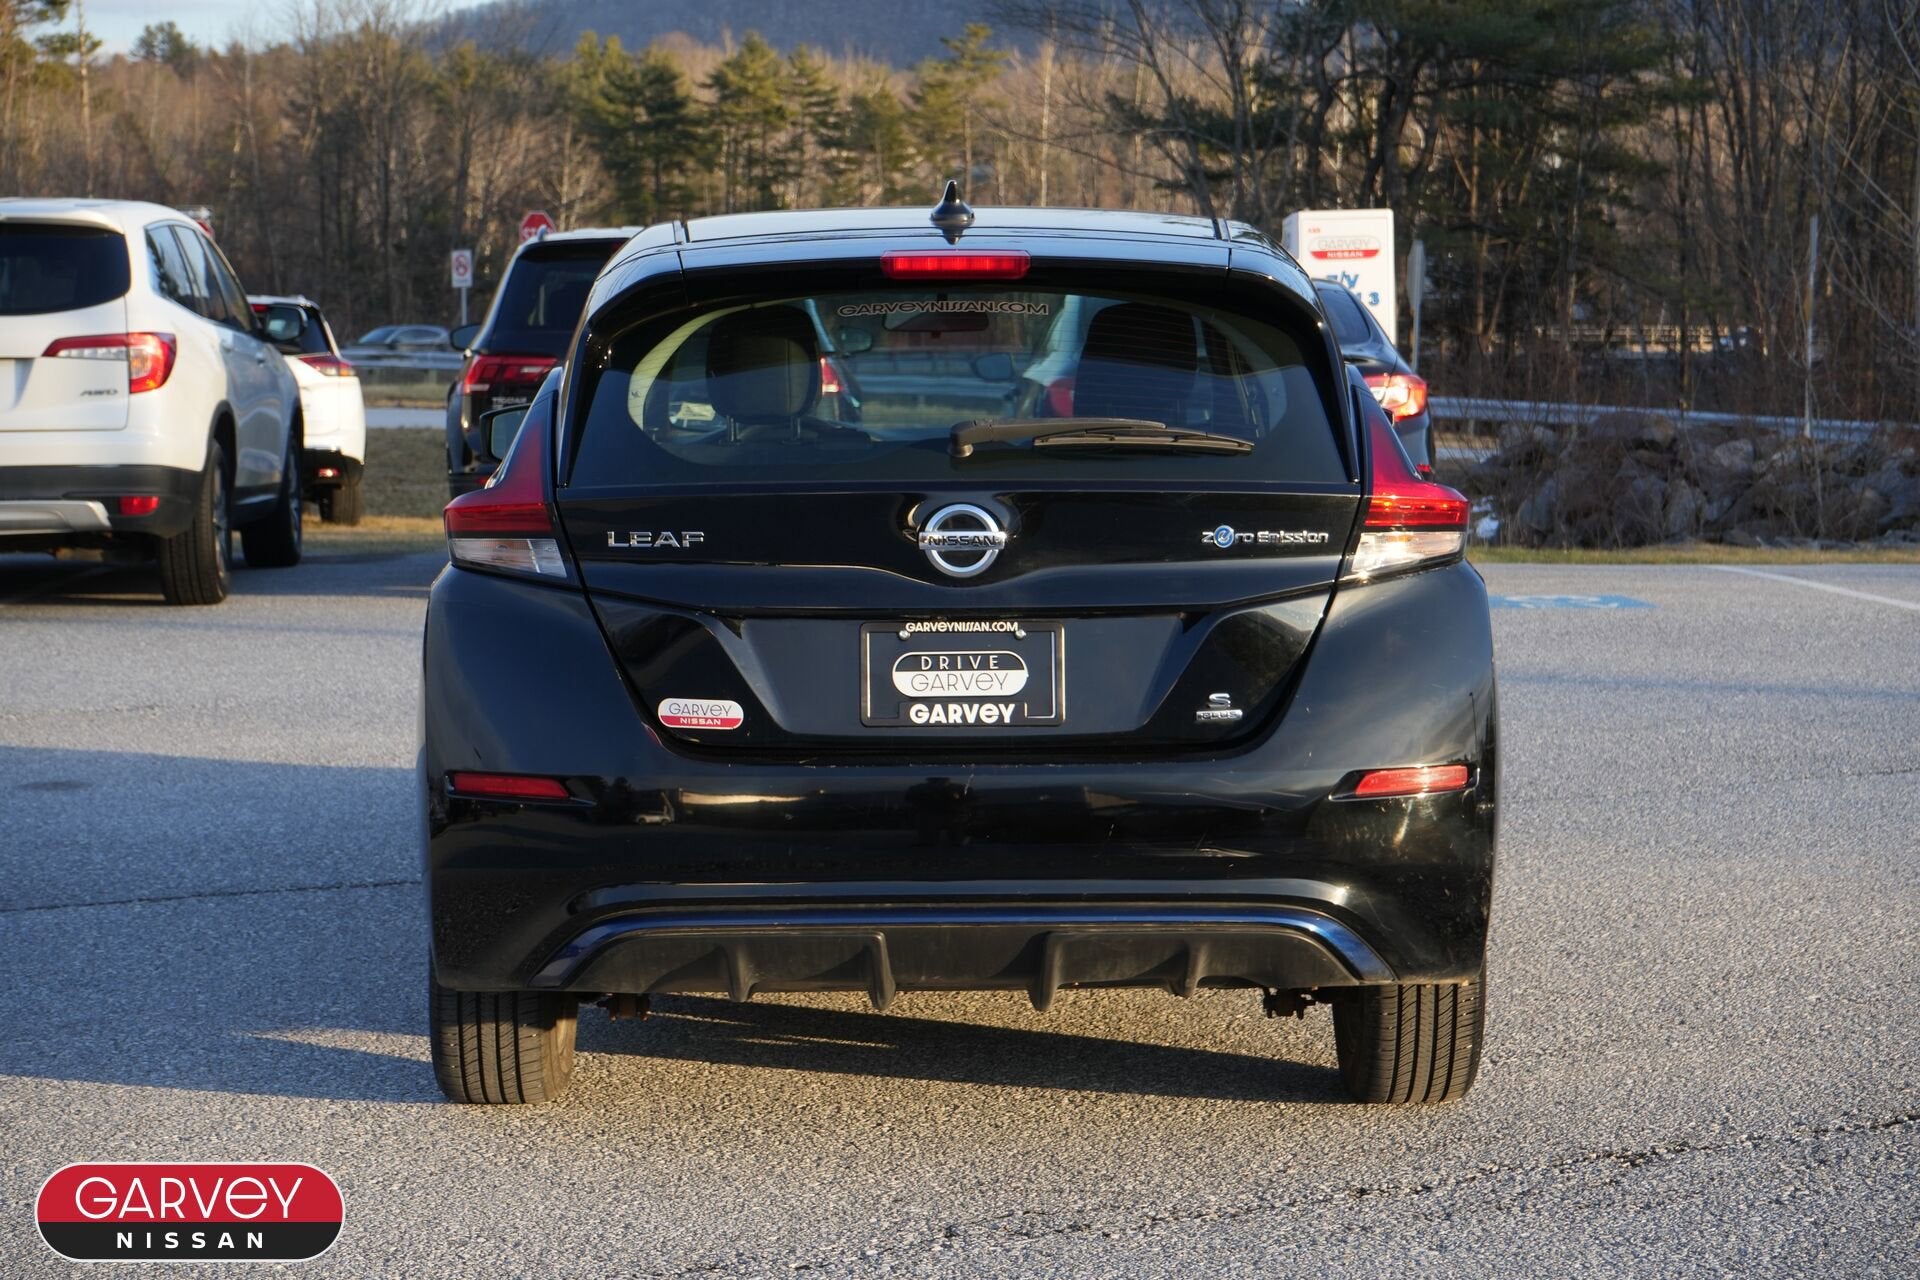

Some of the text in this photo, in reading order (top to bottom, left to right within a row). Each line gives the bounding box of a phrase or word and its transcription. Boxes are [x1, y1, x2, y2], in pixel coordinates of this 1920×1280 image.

[838, 301, 1049, 317] GARVEYNISSAN.COM
[607, 531, 704, 547] LEAF
[928, 535, 996, 546] NISSAN
[1257, 530, 1329, 543] Emission
[905, 621, 1018, 633] GARVEYNISSAN.COM
[921, 655, 999, 671] DRIVE
[911, 672, 1009, 692] GARVEY
[1208, 692, 1231, 709] S
[668, 703, 732, 717] GARVEY
[909, 703, 1016, 724] GARVEY
[680, 717, 721, 726] NISSAN
